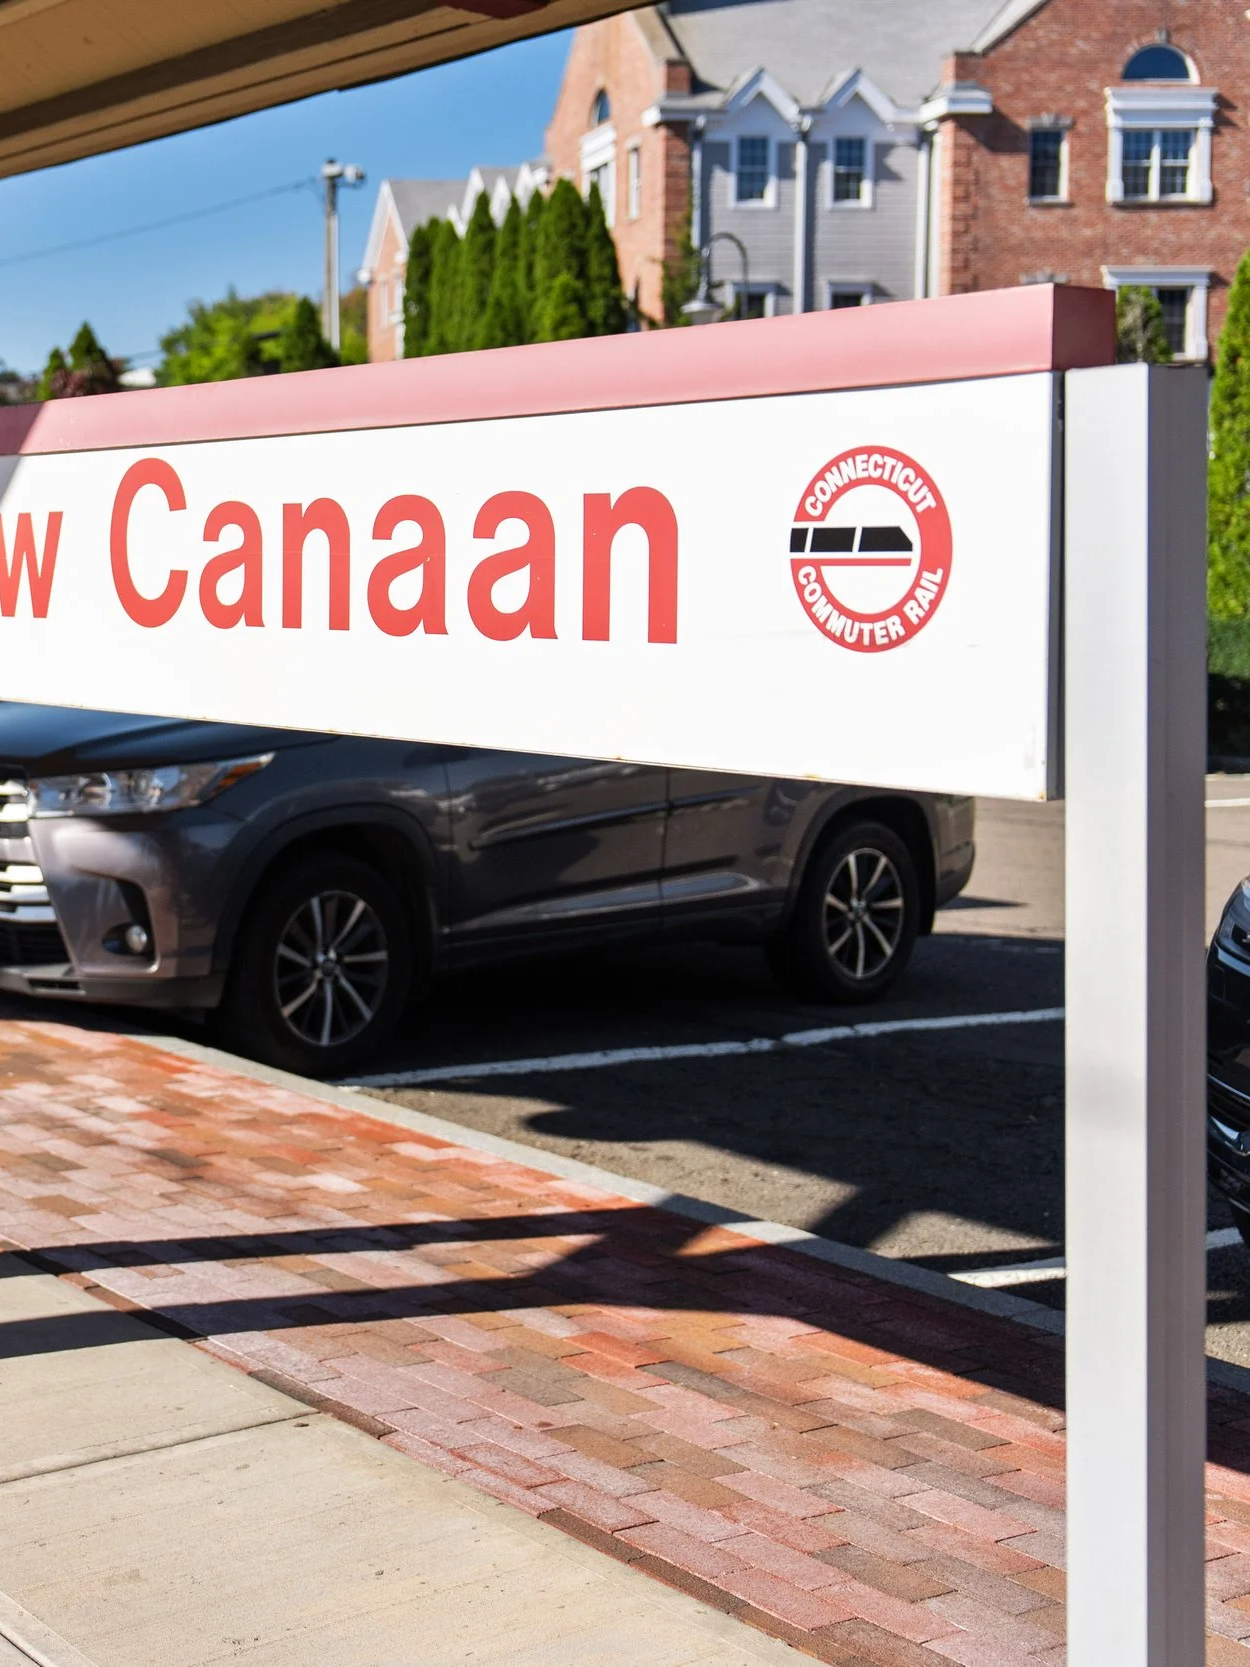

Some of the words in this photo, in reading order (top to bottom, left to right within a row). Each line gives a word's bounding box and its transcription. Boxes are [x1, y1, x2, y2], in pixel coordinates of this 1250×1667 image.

[804, 453, 937, 518] CONNECTICUT
[110, 457, 679, 645] Canaan
[798, 565, 906, 646] COMMUTER
[902, 567, 944, 626] RAIL
